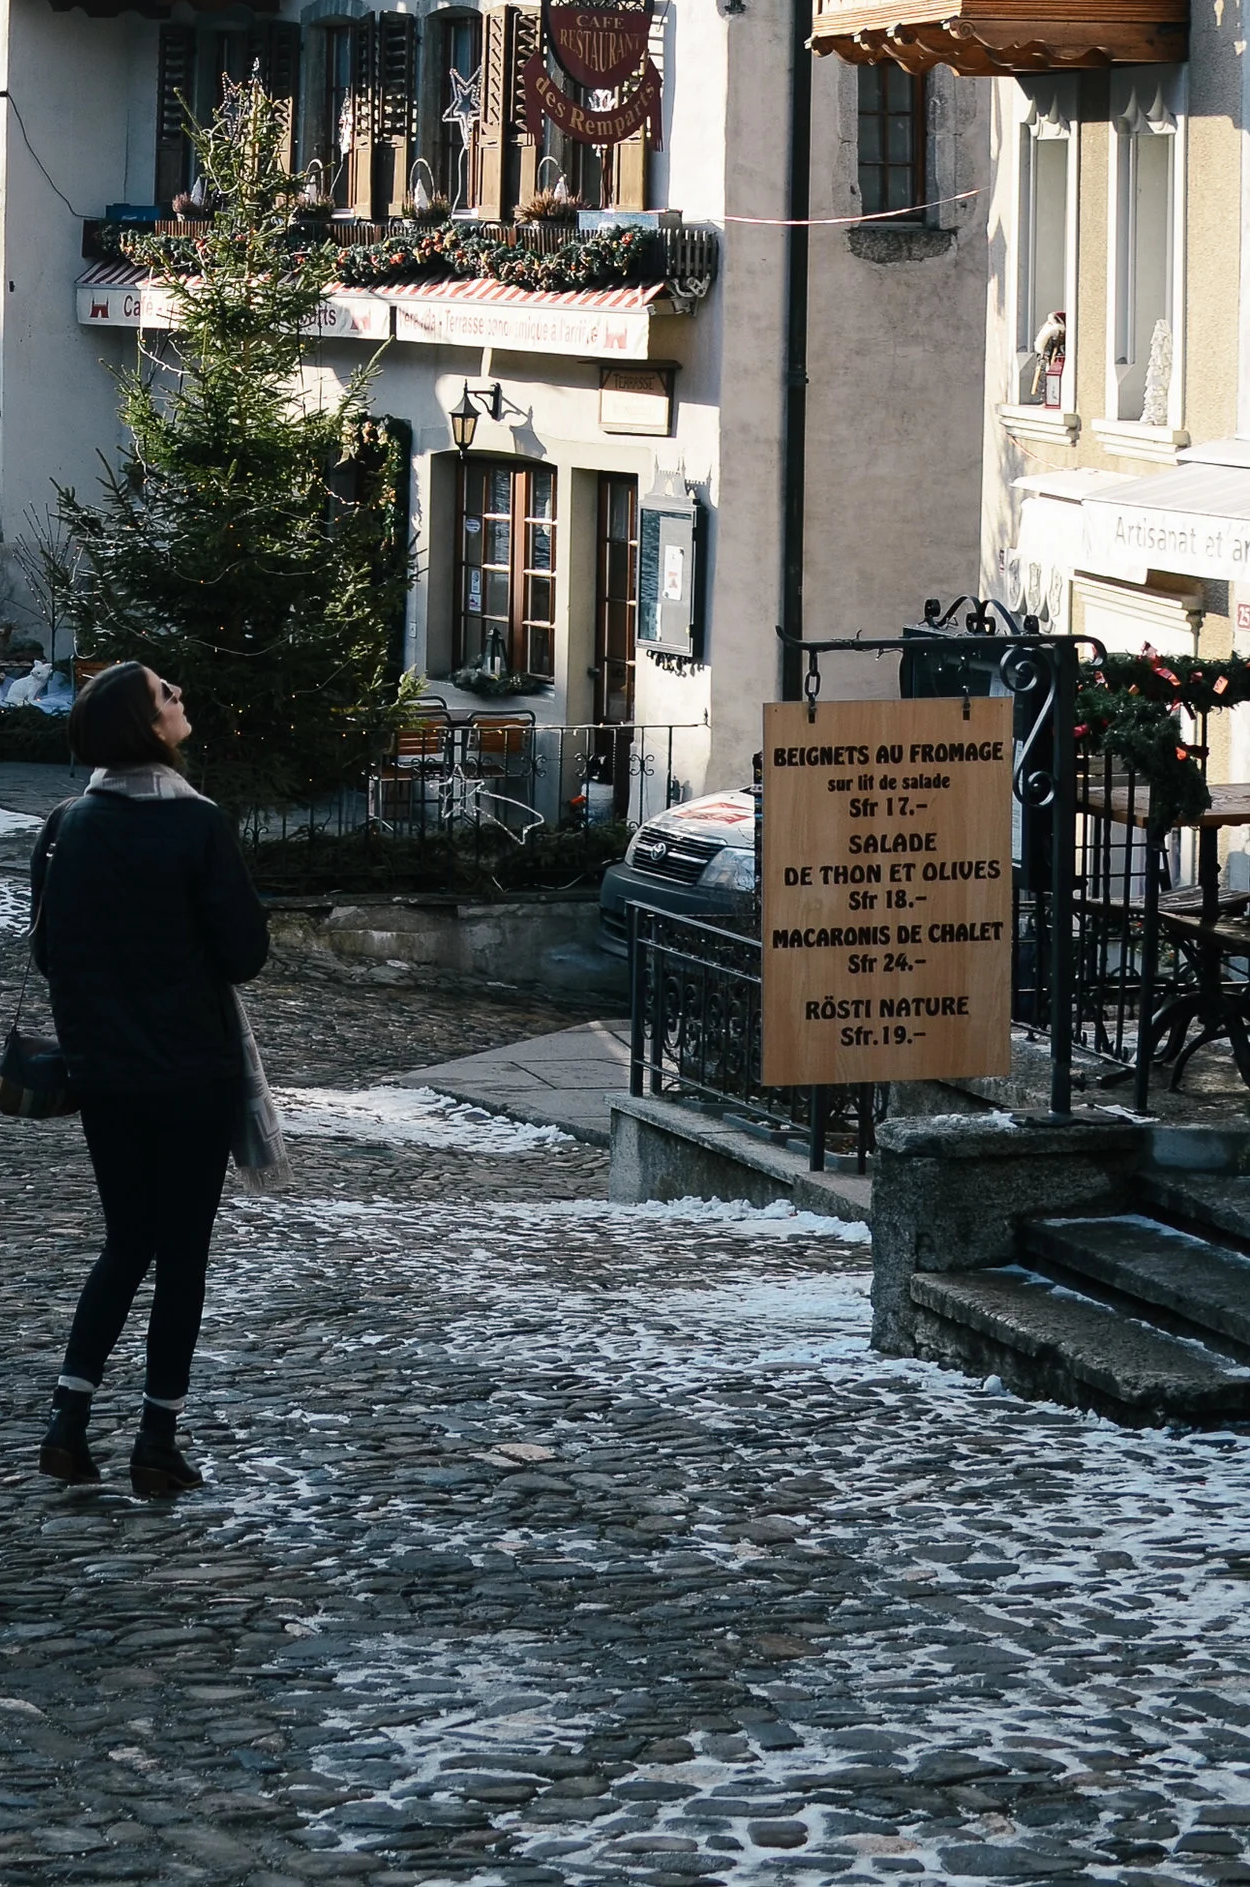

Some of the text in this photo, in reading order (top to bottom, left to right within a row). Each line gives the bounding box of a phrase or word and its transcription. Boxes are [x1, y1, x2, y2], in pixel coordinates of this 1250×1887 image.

[576, 15, 624, 29] CAFE
[560, 29, 639, 72] RESTAURANT
[535, 76, 655, 137] des Remparts
[446, 309, 484, 335] Terrasse
[1116, 516, 1196, 554] Artisanat
[1205, 532, 1222, 558] et
[774, 742, 1003, 766] BEIGNETS AU FROMAGE
[827, 773, 950, 792] sur lit de salade
[850, 798, 878, 817] Sfr
[849, 833, 937, 854] SALADE
[784, 860, 1001, 886] DE THON ET OLIVES
[849, 891, 878, 910] Sfr
[772, 922, 1003, 948] MACARONIS DE CHALET
[848, 954, 878, 973] Sfr
[806, 995, 970, 1020] RÖSTI NATURE
